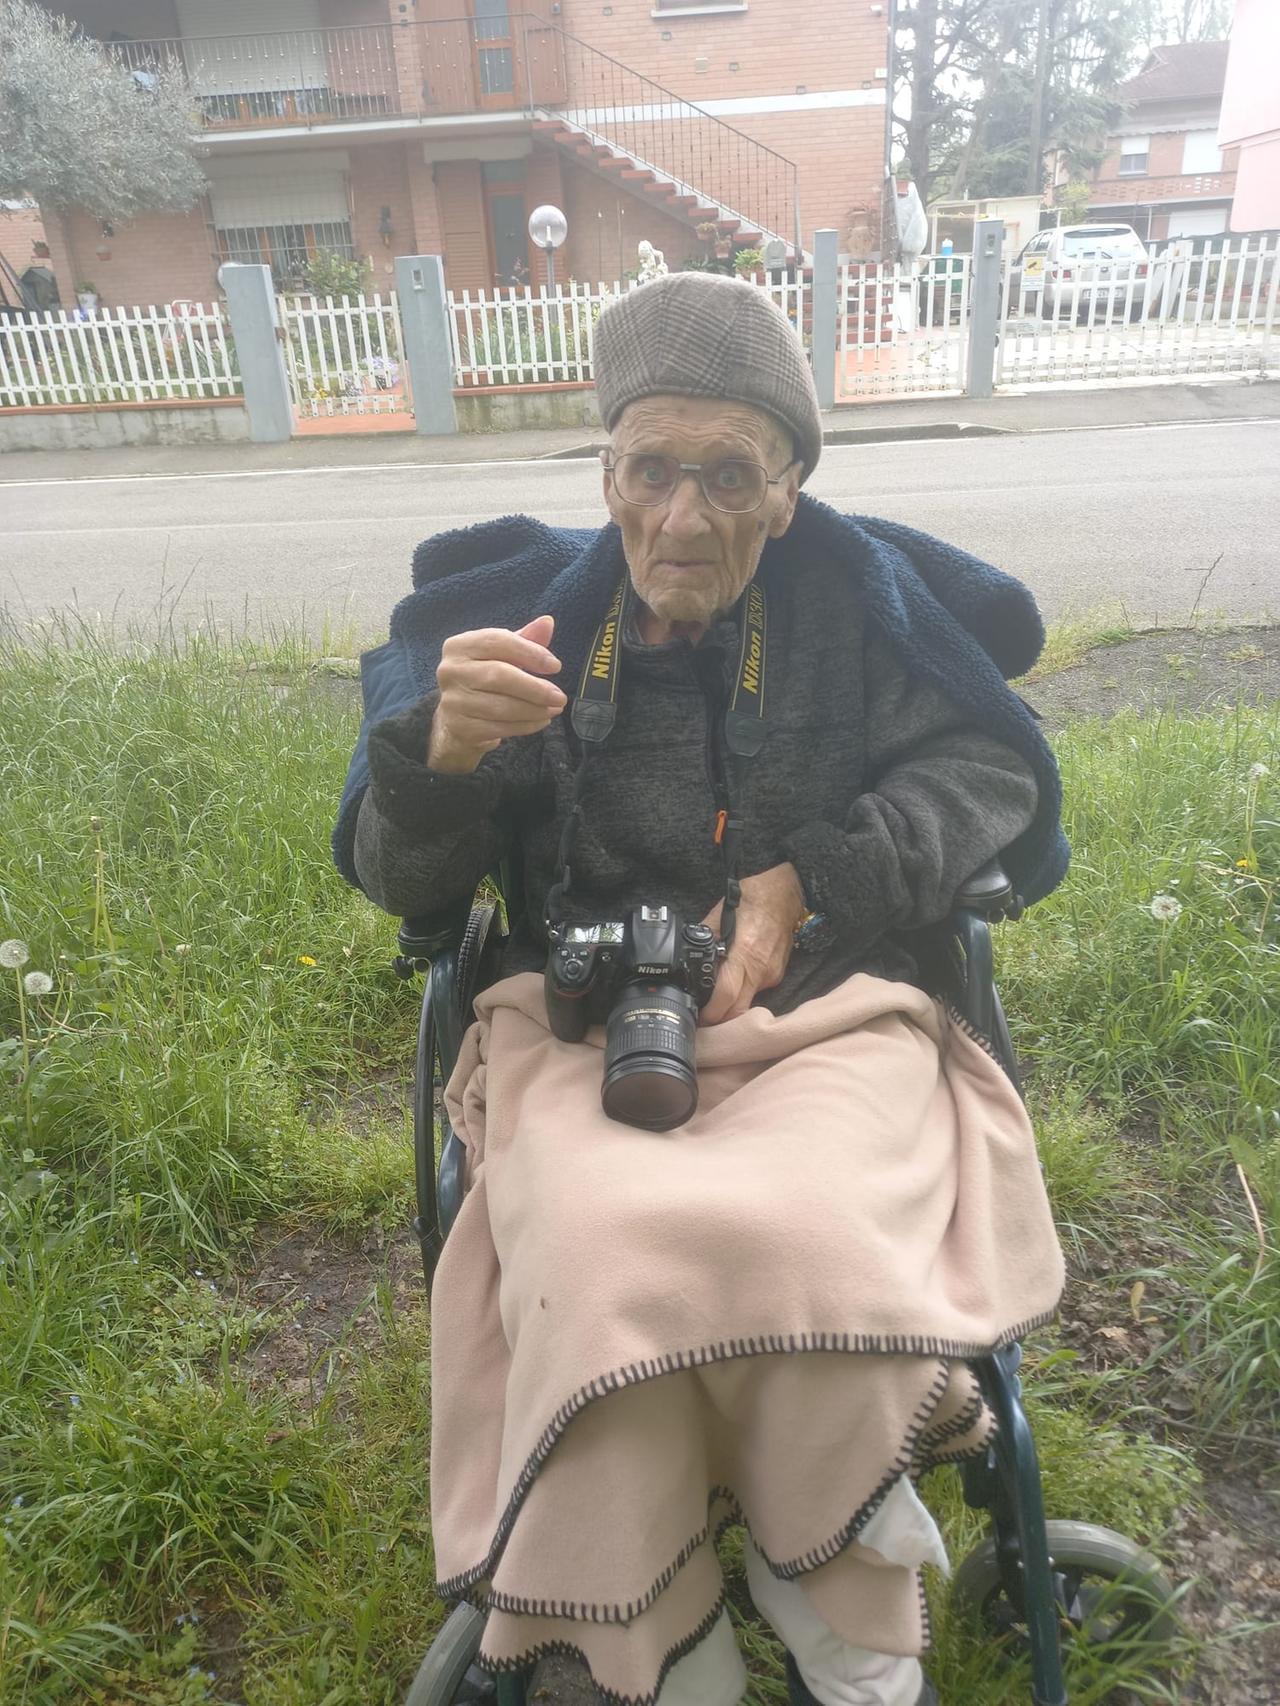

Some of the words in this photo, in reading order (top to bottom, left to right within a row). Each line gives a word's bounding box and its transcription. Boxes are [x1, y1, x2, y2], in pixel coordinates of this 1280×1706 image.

[592, 622, 616, 678] Nikon
[743, 631, 762, 694] Nikon
[638, 966, 669, 974] Nikon
